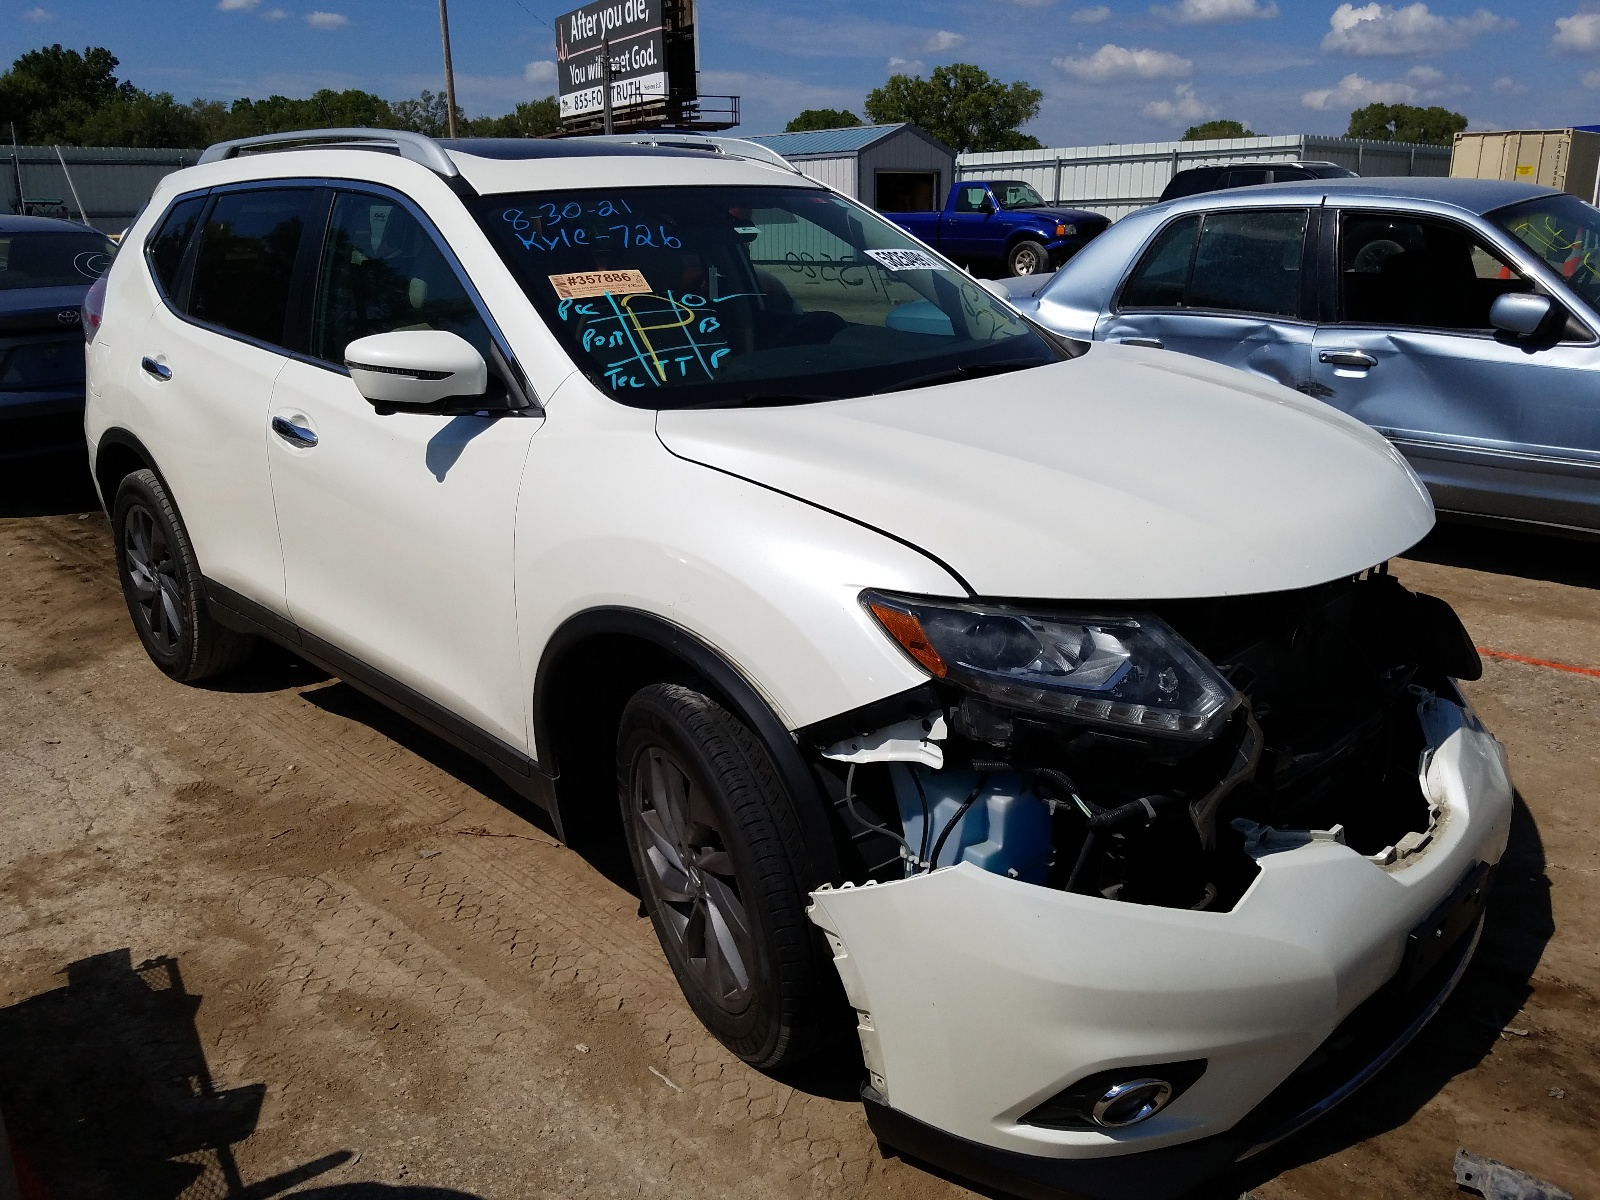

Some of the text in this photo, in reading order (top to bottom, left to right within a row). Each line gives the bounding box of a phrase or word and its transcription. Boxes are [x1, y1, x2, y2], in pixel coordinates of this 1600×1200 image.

[570, 10, 598, 43] After
[599, 4, 622, 41] you
[569, 63, 586, 86] You
[631, 39, 658, 70] God.
[502, 198, 633, 231] 8-30-21
[566, 271, 632, 287] #357886
